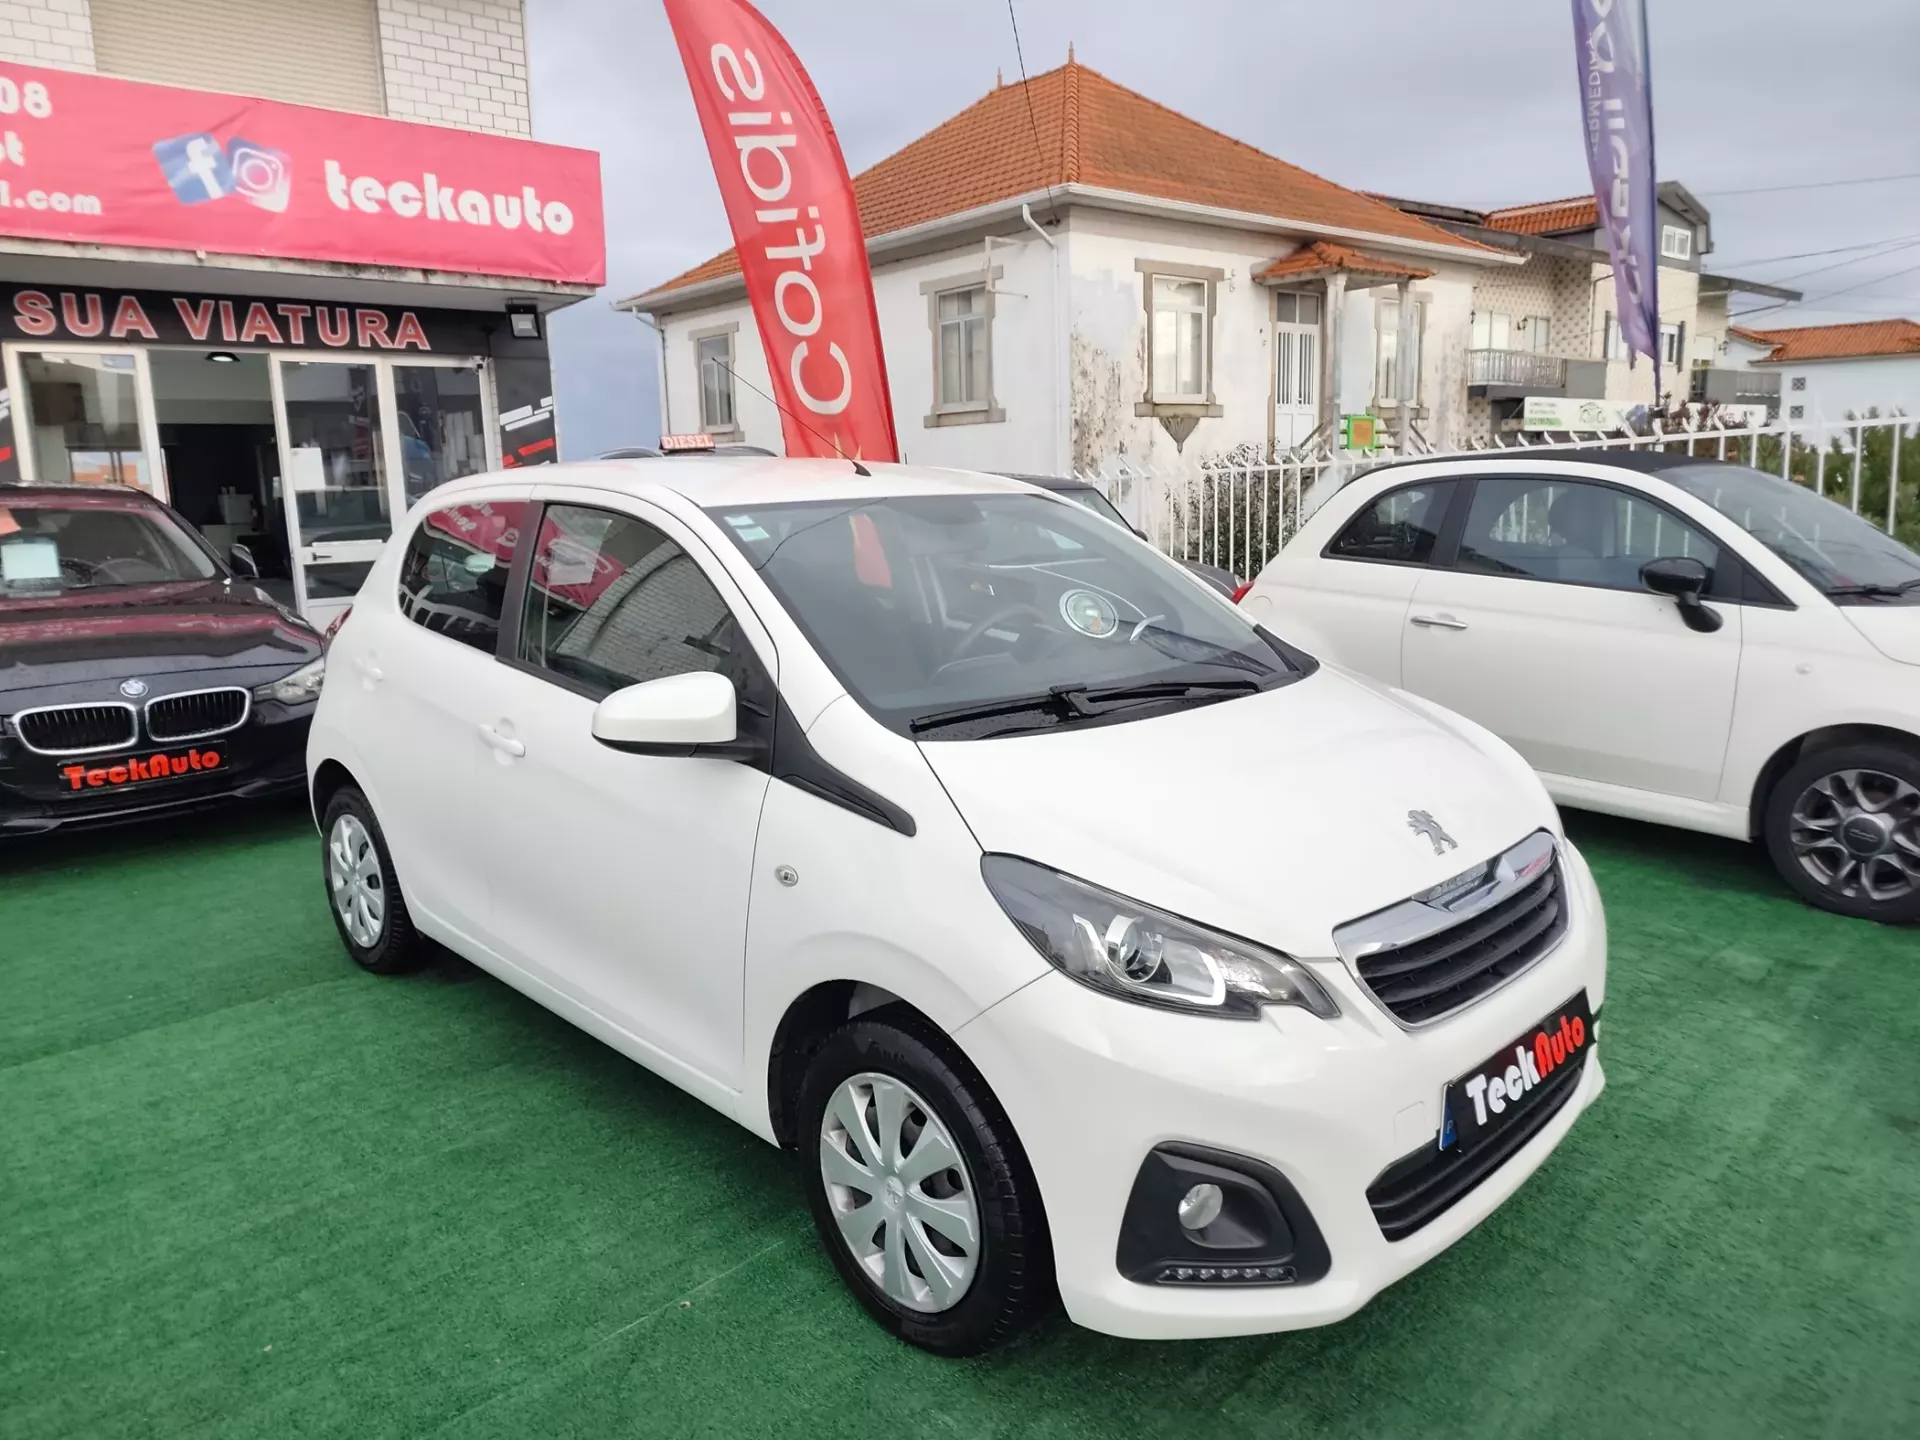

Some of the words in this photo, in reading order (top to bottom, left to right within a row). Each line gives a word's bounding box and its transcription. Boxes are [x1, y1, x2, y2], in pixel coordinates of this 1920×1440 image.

[323, 158, 574, 236] teckauto
[13, 291, 158, 341] SUA
[172, 298, 431, 351] VIATURA
[662, 434, 714, 449] DIESEL
[63, 749, 220, 790] TeckAuto
[1465, 1015, 1585, 1126] TeckAuto
